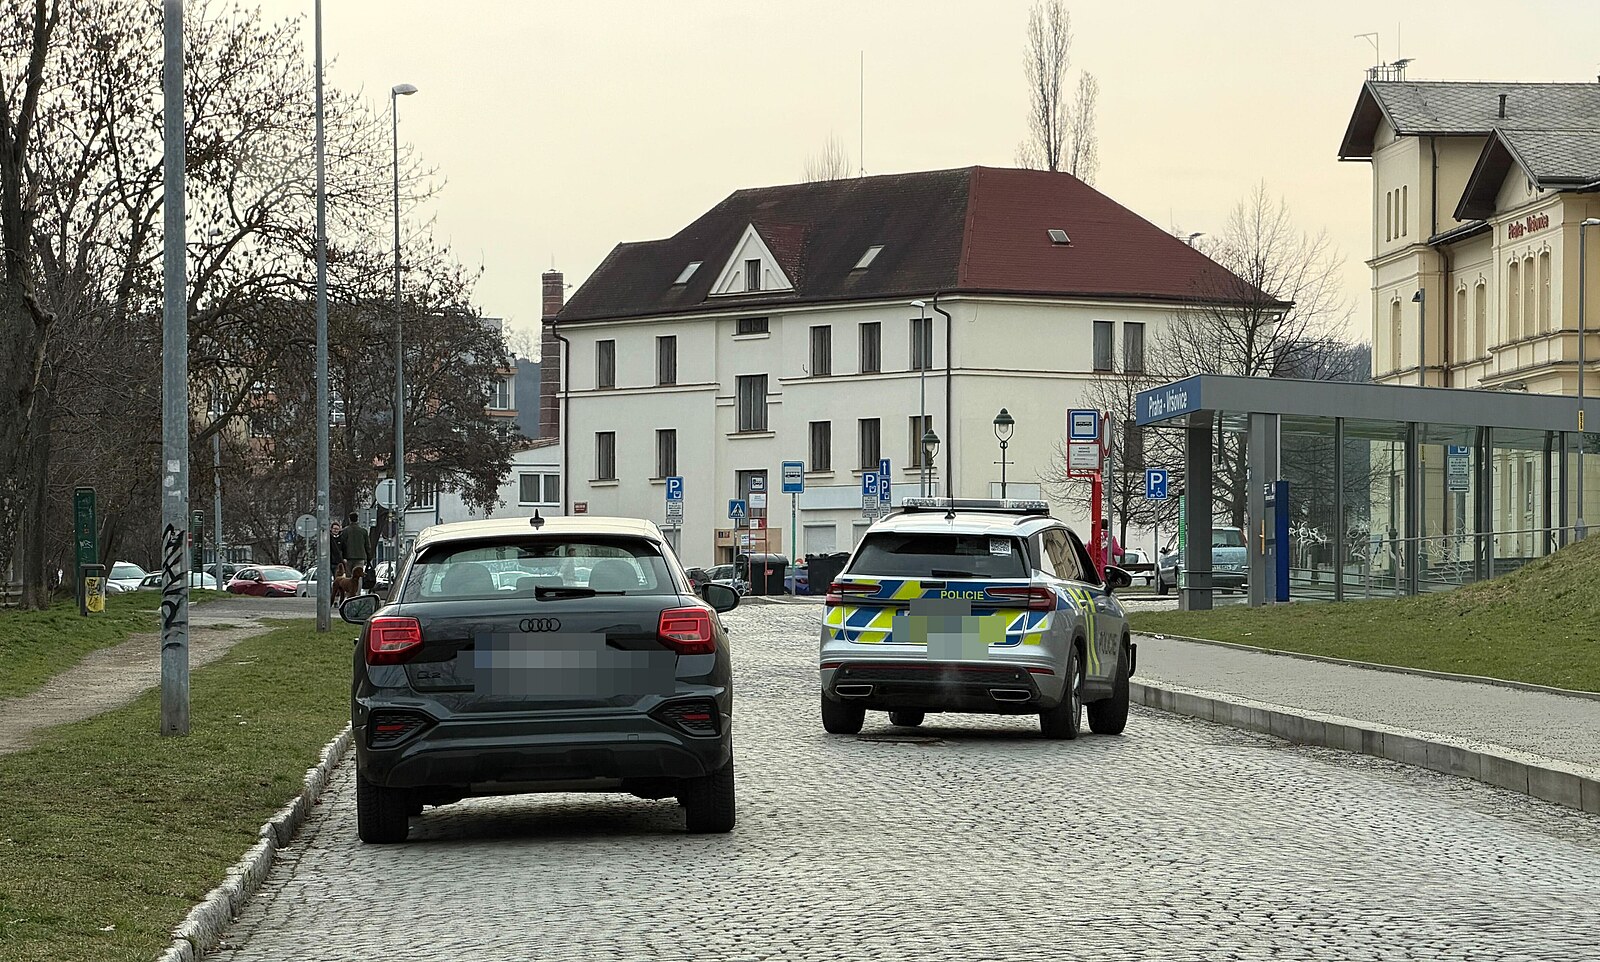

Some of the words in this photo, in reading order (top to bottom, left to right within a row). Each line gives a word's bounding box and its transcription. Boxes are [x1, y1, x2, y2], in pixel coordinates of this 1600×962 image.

[1148, 394, 1163, 418] Praha
[1166, 387, 1187, 413] Vršovice
[669, 479, 680, 494] P
[865, 474, 875, 488] P
[881, 480, 888, 494] P
[1150, 473, 1163, 490] P
[940, 590, 985, 600] POLICIE
